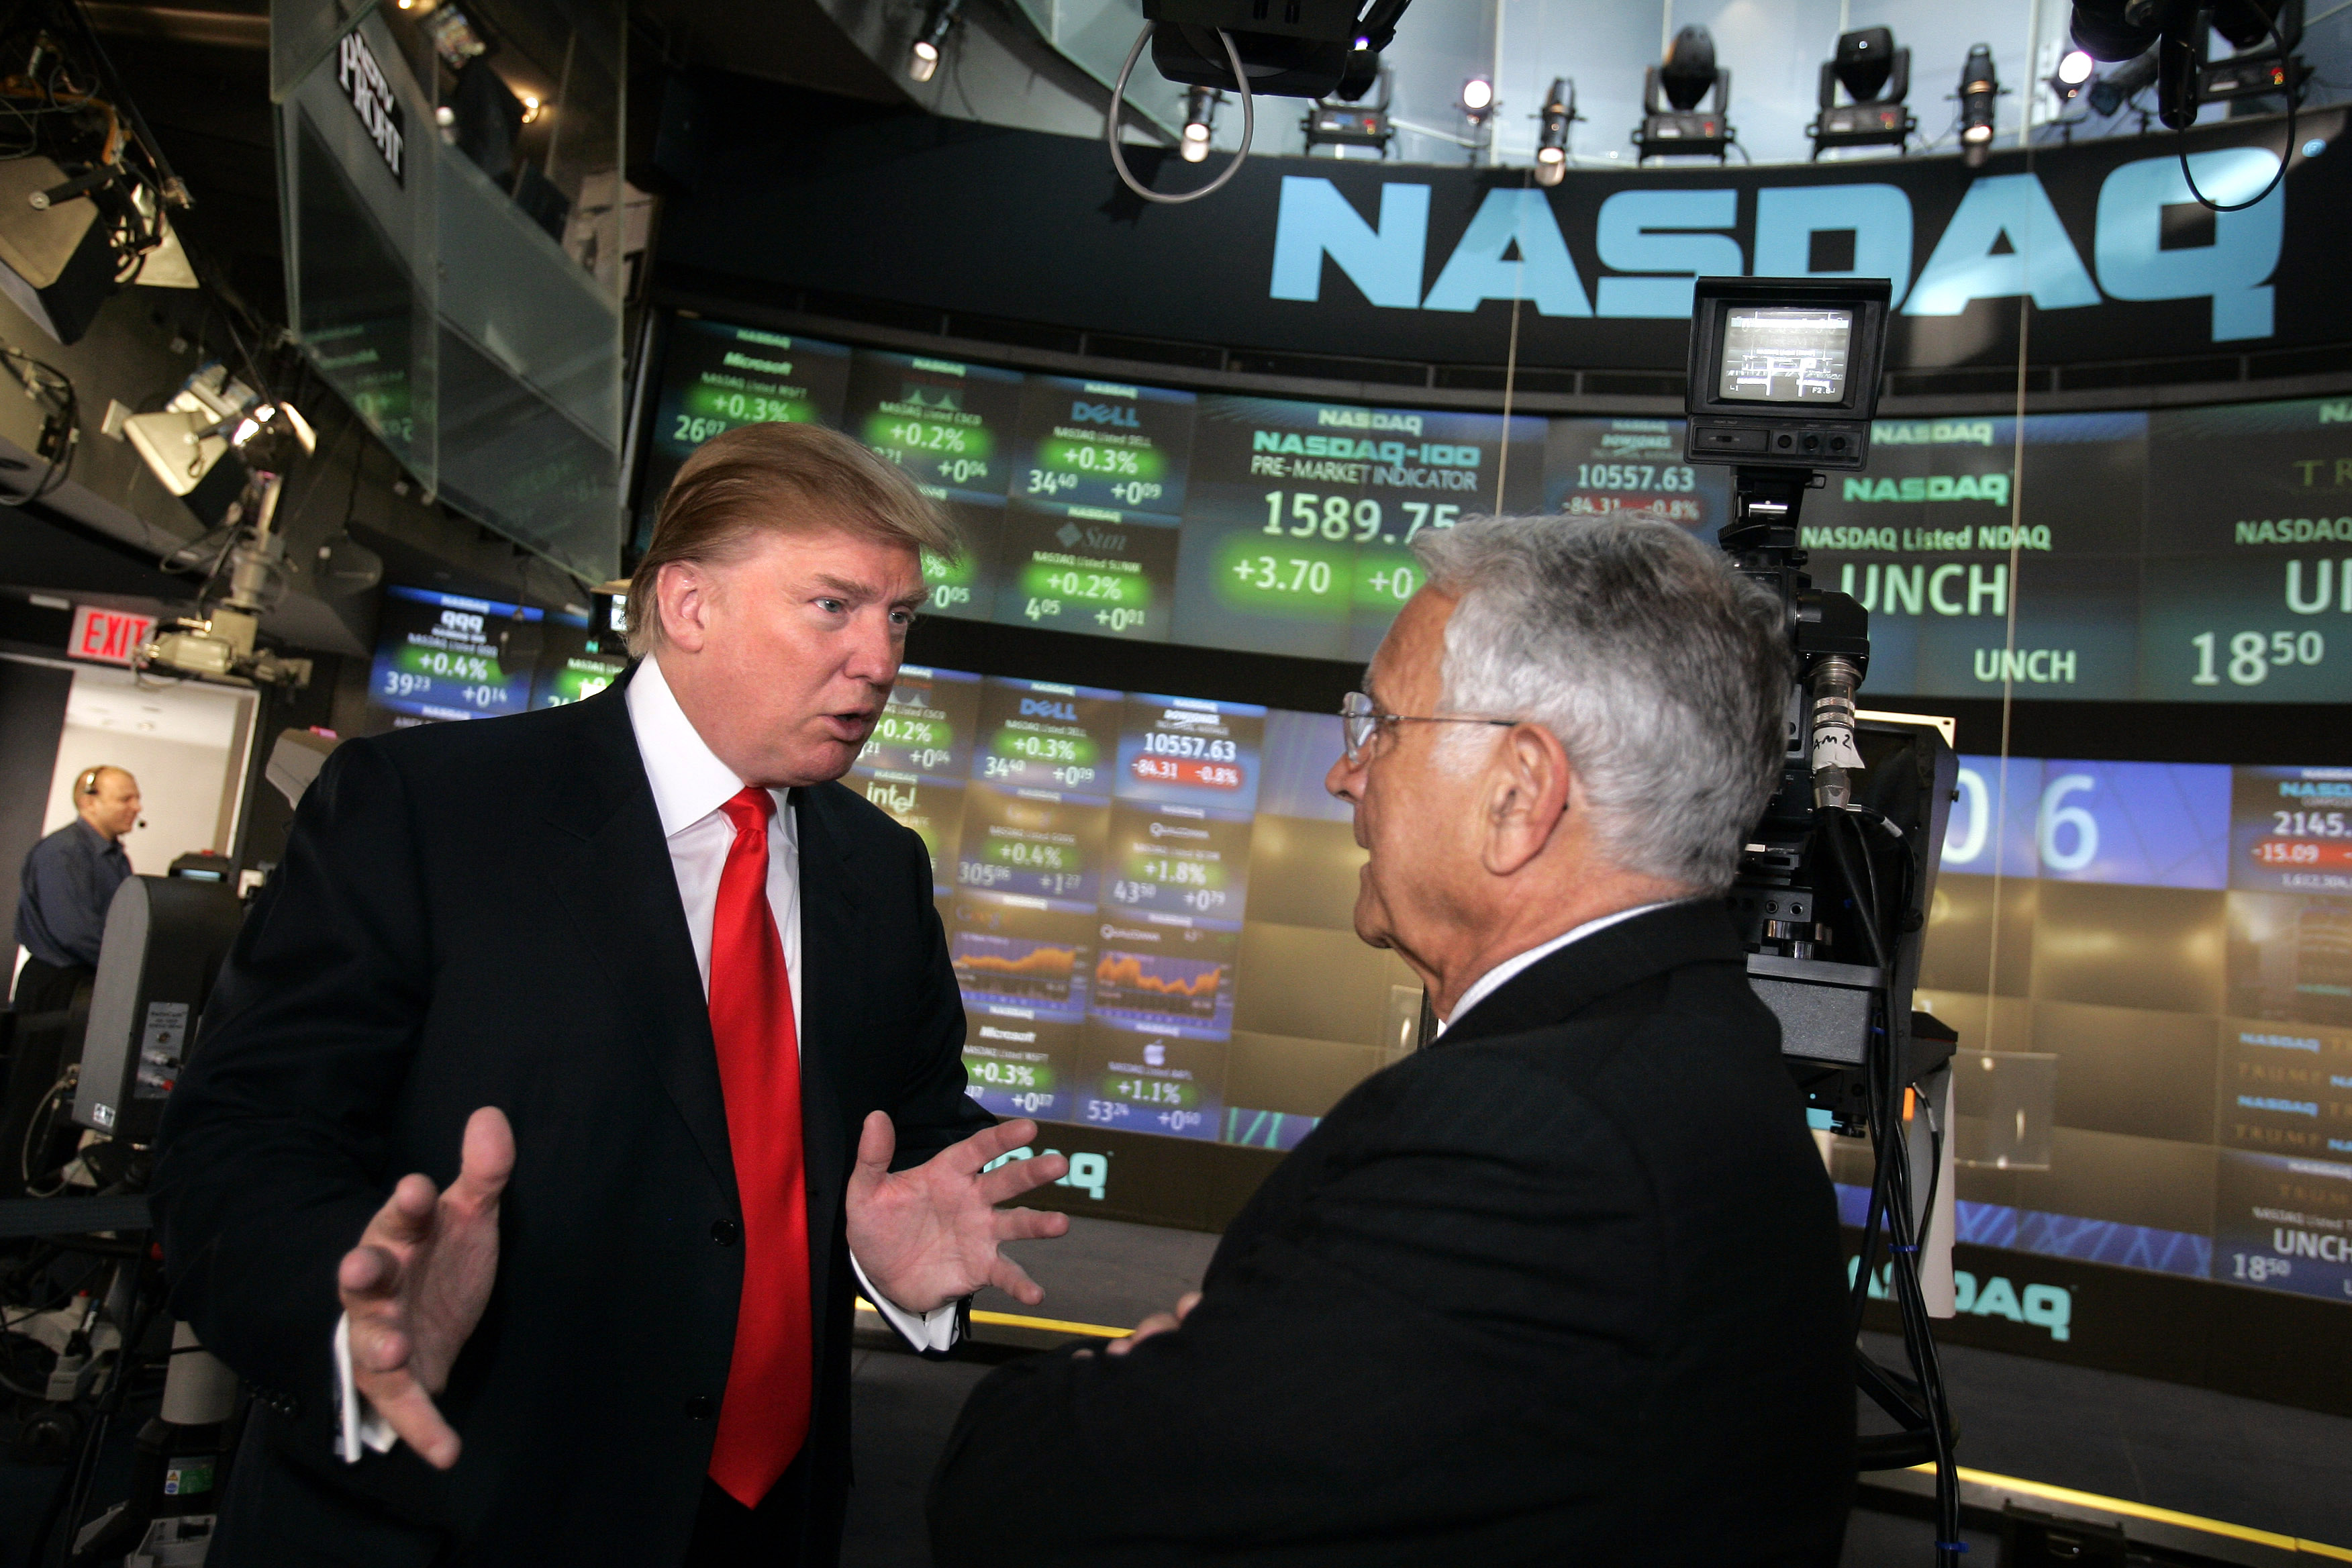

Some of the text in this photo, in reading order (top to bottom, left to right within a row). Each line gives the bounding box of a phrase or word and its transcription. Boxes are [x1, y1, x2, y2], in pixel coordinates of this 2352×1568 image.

[1269, 146, 2287, 342] NASDAQ
[714, 393, 790, 422] +0.3%
[1072, 401, 1140, 428] DELL
[890, 422, 965, 453] +0.2%
[1317, 409, 1424, 437] NASDAQ
[1871, 422, 1994, 446] NASDAQ
[1063, 446, 1140, 476] +0.3%
[1253, 430, 1481, 467] NASDAQ-100
[1250, 454, 1477, 491] PRE-MARKET INDICATOR
[1577, 463, 1696, 492] 10557.63
[1843, 473, 2010, 507] NASDAQ
[1262, 490, 1461, 544] 1589.75
[1800, 524, 2052, 552] NASDAQ Listed NDAQ
[1046, 571, 1124, 601] +0.2%
[1232, 556, 1414, 600] +3.70 +0
[1840, 563, 2008, 616] UNCH
[81, 610, 150, 658] EXIT
[419, 651, 489, 683] +0.4%
[1973, 648, 2077, 683] UNCH
[1019, 697, 1078, 722] DELL
[873, 718, 933, 743] +0.2%
[1813, 734, 1838, 751] AM
[1014, 736, 1076, 762] +0.3%
[1144, 732, 1236, 763] 10557.63
[1131, 758, 1178, 780] -84.31
[2039, 773, 2100, 871] 6
[999, 842, 1063, 869] +0.4%
[2251, 842, 2320, 865] -15.09
[1144, 859, 1207, 887] +1.8%
[972, 1062, 1035, 1087] +0.3%
[1117, 1079, 1182, 1106] +1.1%
[2273, 1227, 2352, 1265] UNCH
